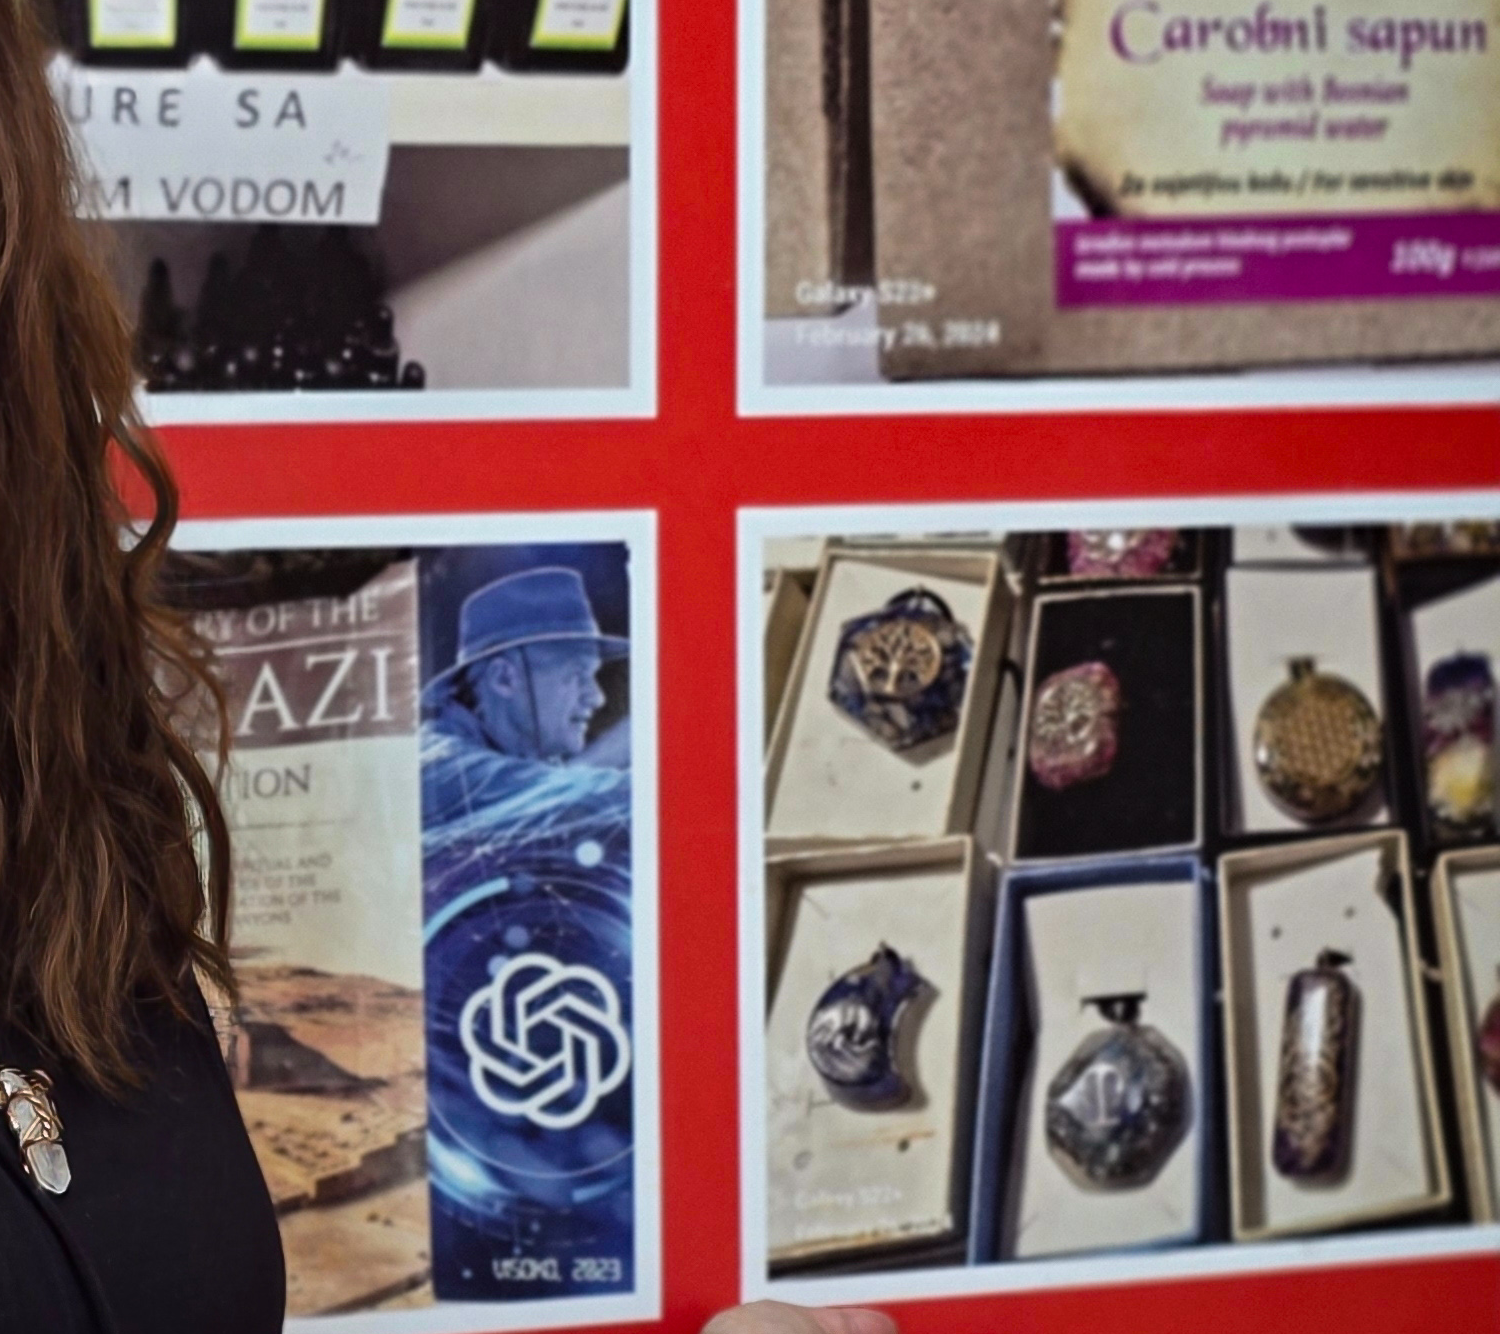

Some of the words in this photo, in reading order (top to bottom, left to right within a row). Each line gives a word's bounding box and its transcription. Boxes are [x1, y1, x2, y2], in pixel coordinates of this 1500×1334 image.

[1347, 17, 1488, 71] sapun
[235, 87, 307, 129] SA
[159, 175, 346, 218] VODOM
[246, 602, 300, 637] OF
[303, 589, 381, 628] THE
[235, 642, 394, 736] AZI
